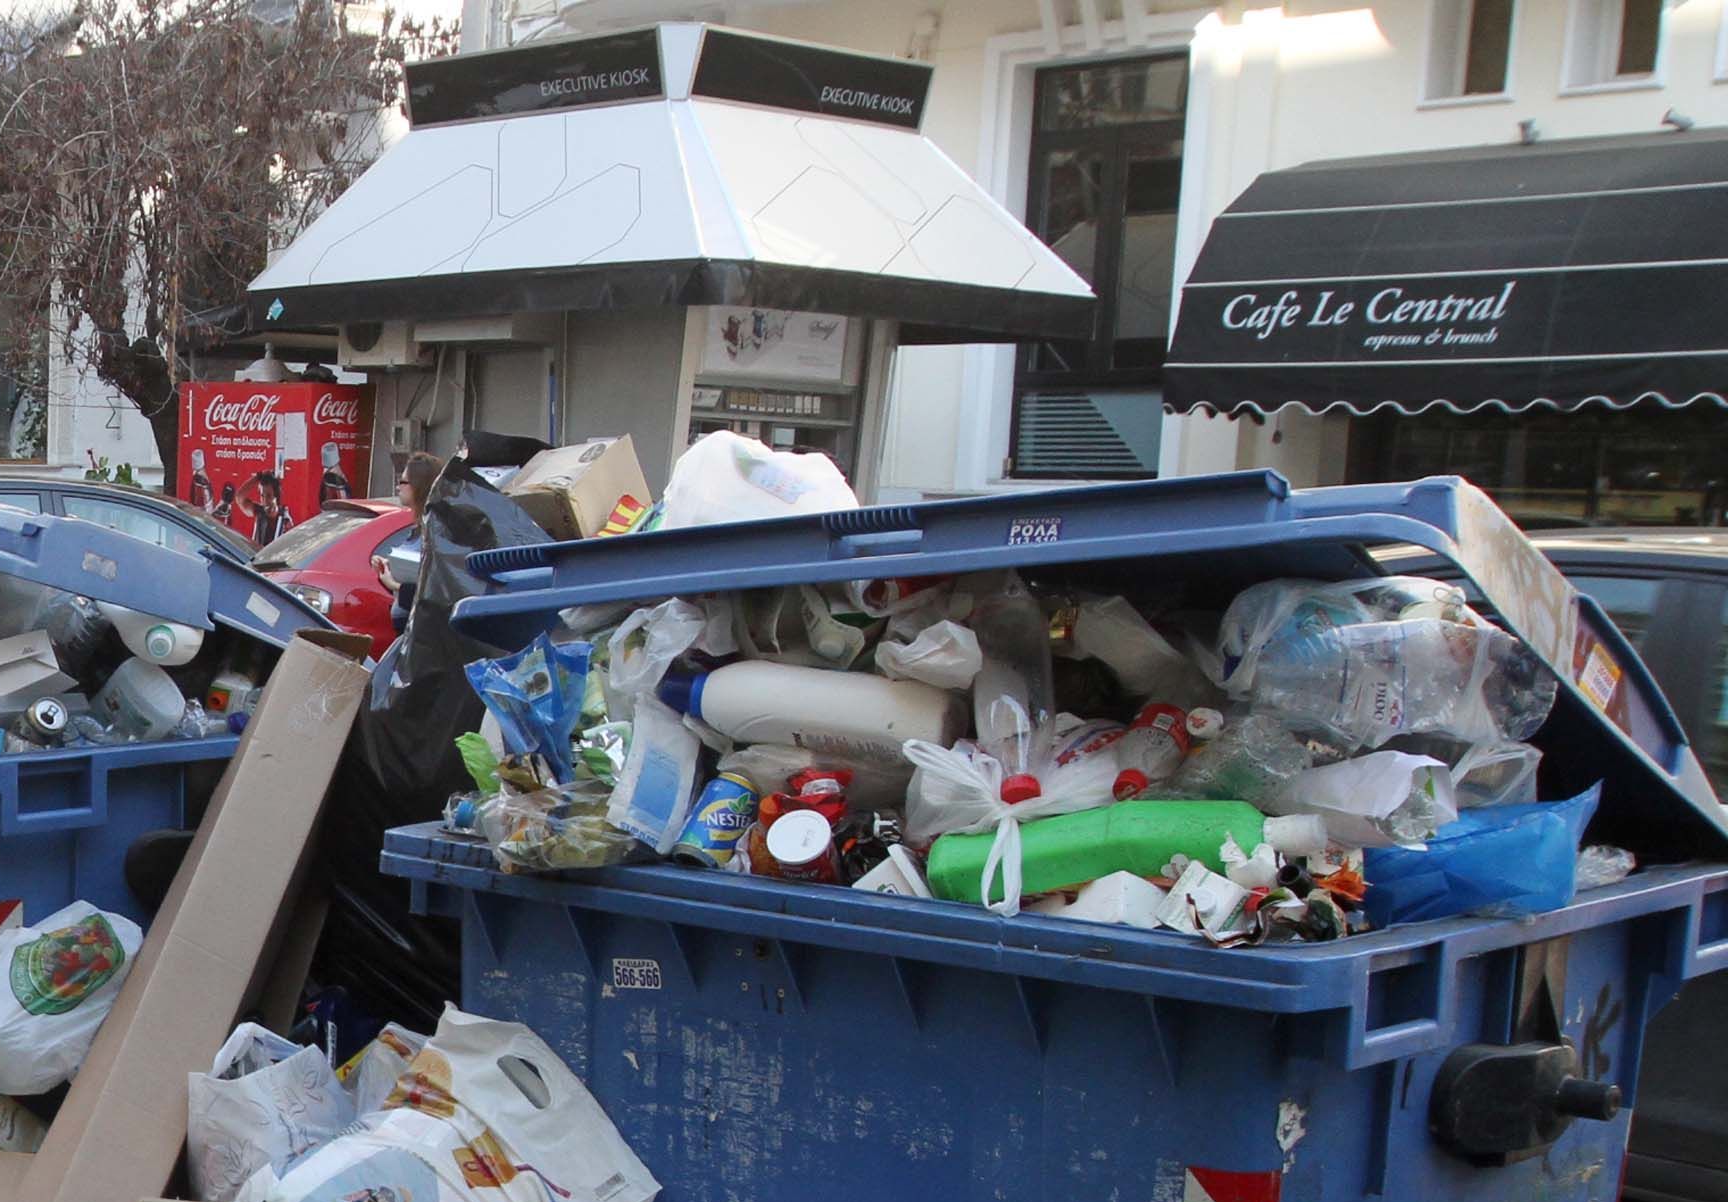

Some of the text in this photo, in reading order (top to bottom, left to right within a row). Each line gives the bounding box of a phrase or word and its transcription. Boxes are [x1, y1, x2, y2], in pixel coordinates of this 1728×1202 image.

[540, 68, 650, 97] EXECUTIVE KIOSK
[820, 86, 915, 115] EXECUTIVE KIOSK
[1222, 281, 1517, 340] Cafe Le Central
[1364, 327, 1498, 351] espresso & brunch
[204, 394, 280, 431] Coca-Cola
[1010, 524, 1058, 537] ΡΟΛΑ
[615, 967, 661, 988] 566-566
